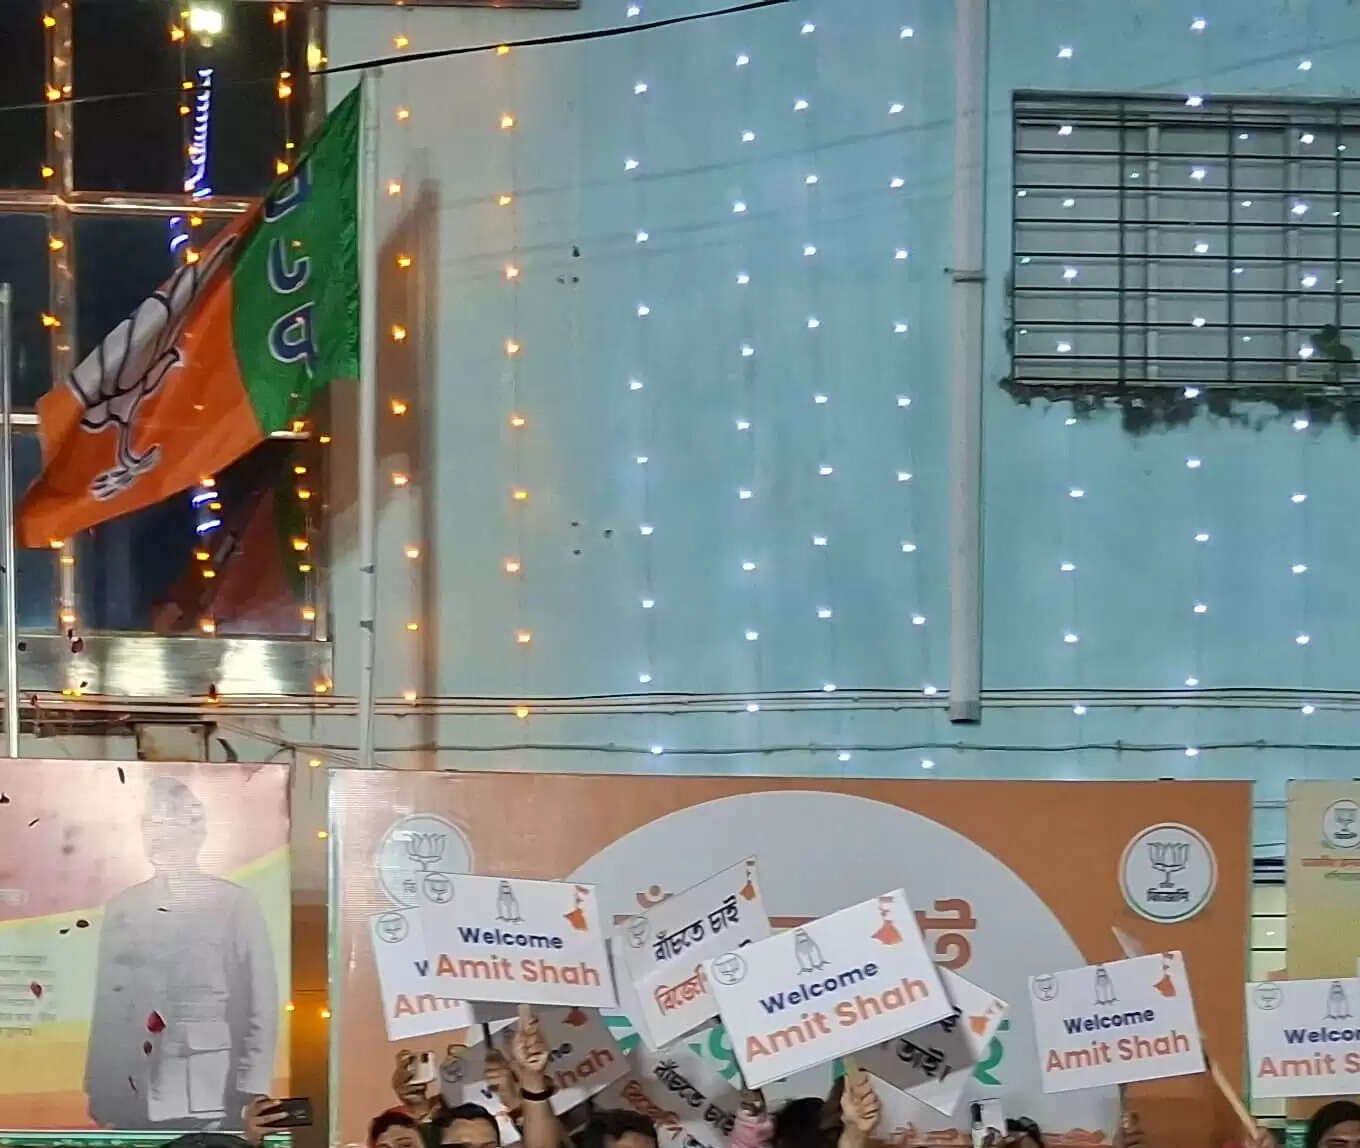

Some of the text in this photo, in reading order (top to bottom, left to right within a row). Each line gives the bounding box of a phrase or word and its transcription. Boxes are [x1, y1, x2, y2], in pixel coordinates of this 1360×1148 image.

[707, 894, 739, 934] চাই
[458, 926, 564, 951] Welcome
[436, 953, 515, 982] Amit
[521, 957, 601, 988] Shah
[760, 961, 879, 1016] Welcome
[745, 1013, 832, 1063] Amit
[834, 977, 929, 1027] Shah
[1062, 1007, 1155, 1036] Welcome
[1046, 1042, 1112, 1074] Amit
[1117, 1030, 1191, 1063] Shah
[1257, 1052, 1337, 1079] Amit
